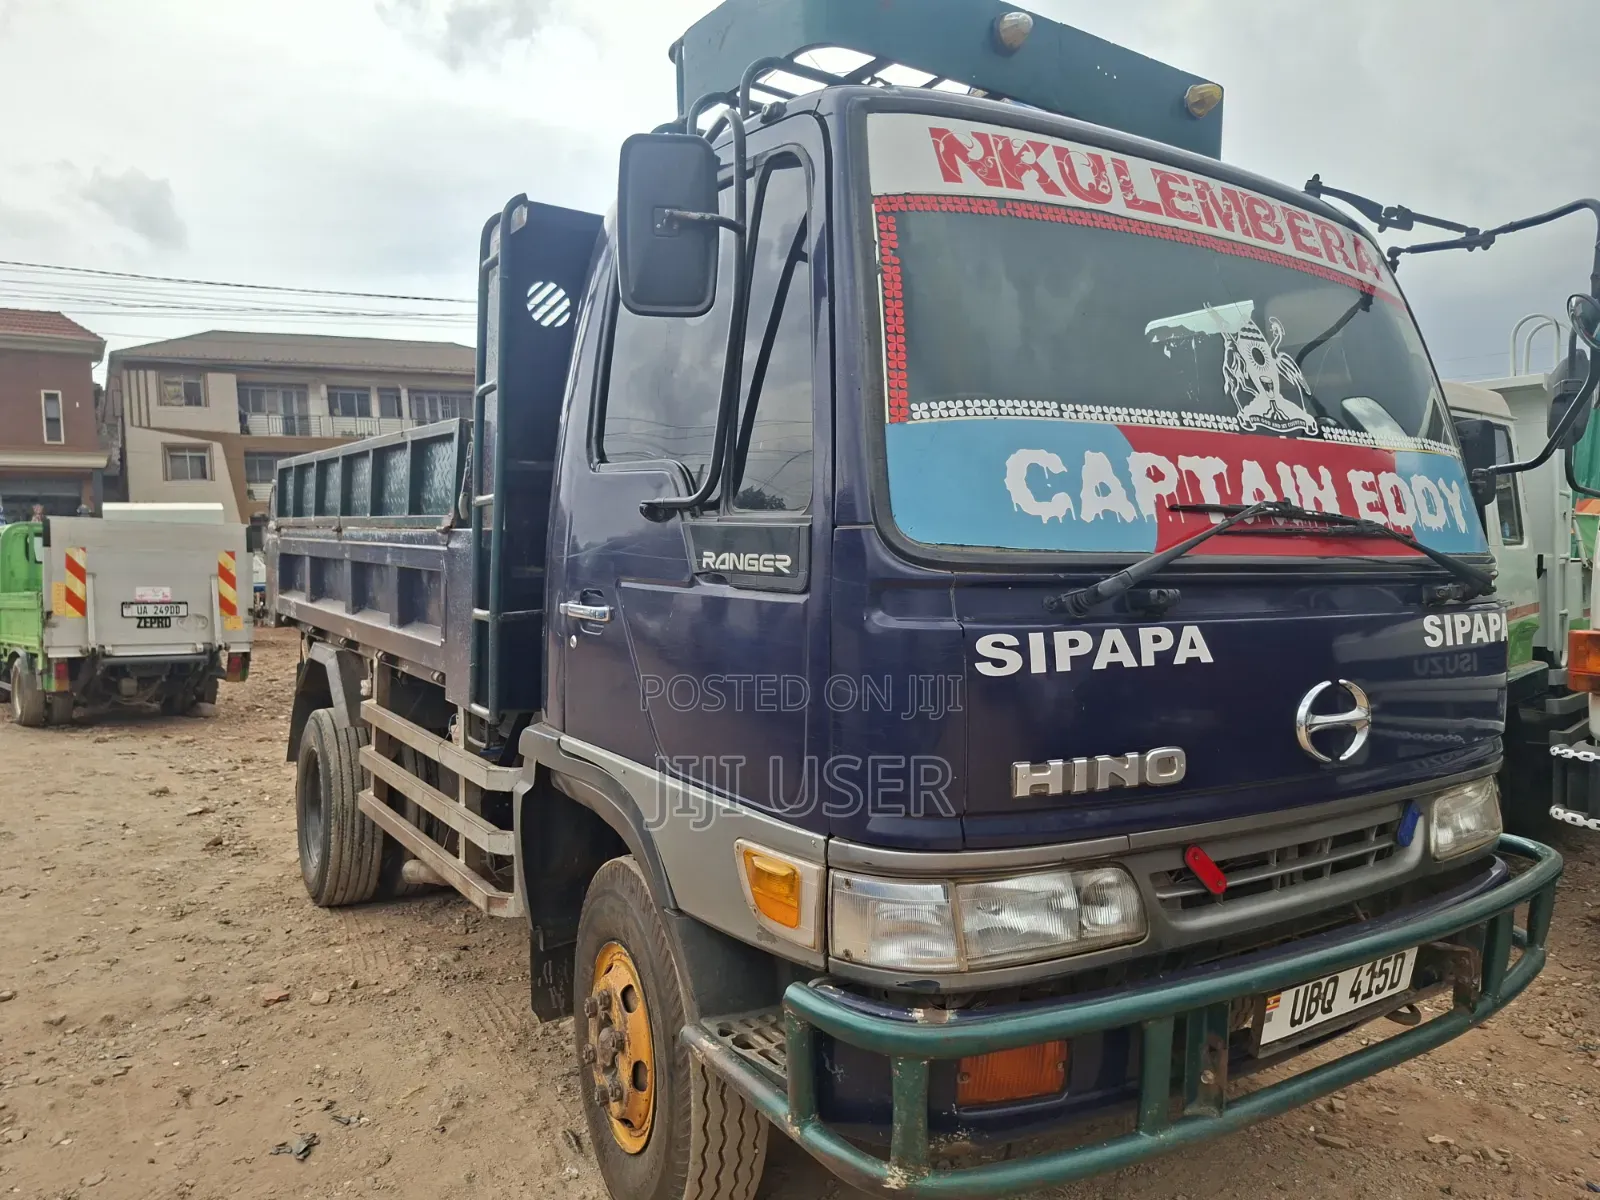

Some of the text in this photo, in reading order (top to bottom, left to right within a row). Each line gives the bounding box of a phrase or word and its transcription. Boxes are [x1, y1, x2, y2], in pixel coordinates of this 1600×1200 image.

[1004, 448, 1469, 533] CAPTAIN EDDY
[702, 551, 792, 574] RANGER
[136, 605, 148, 615] UA
[974, 625, 1214, 677] SIPAPA
[1011, 746, 1187, 798] HINO
[1289, 951, 1406, 1028] UBQ 415D
